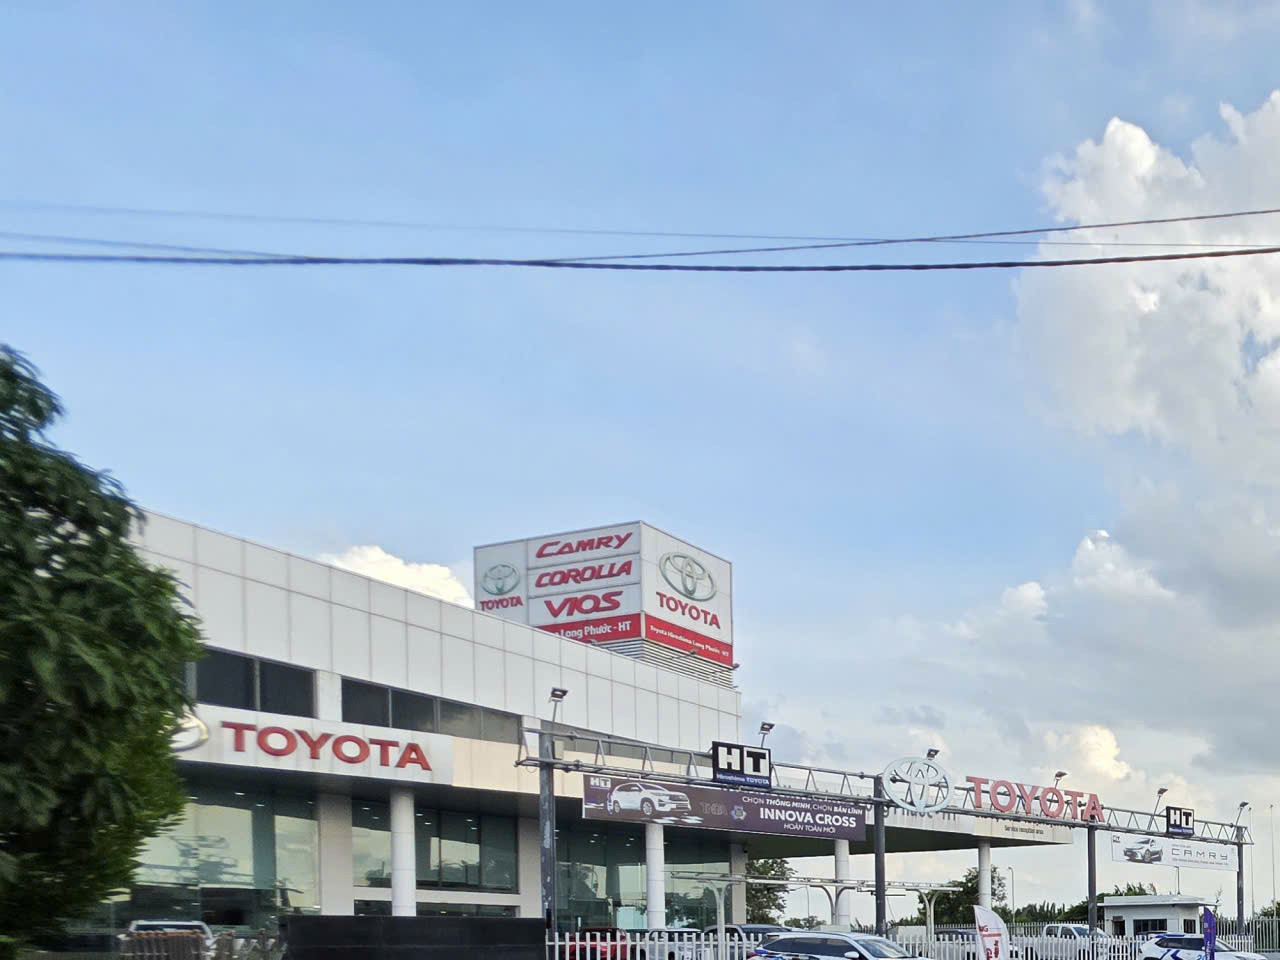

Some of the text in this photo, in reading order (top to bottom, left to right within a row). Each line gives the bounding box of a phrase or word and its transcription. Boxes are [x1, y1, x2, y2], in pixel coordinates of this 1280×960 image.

[536, 532, 633, 559] CAMRY
[534, 560, 633, 588] COROLLA
[480, 595, 523, 611] TOYOTA
[544, 591, 624, 618] VIOS
[655, 591, 721, 630] TOYOTA
[618, 621, 631, 631] HT
[222, 720, 433, 772] TOYOTA
[718, 746, 768, 774] HT
[590, 777, 611, 788] HT
[966, 776, 1105, 822] TOYOTA
[760, 807, 856, 827] INNOVA CROSS
[1170, 809, 1192, 826] HT
[1172, 848, 1228, 861] CAMRY
